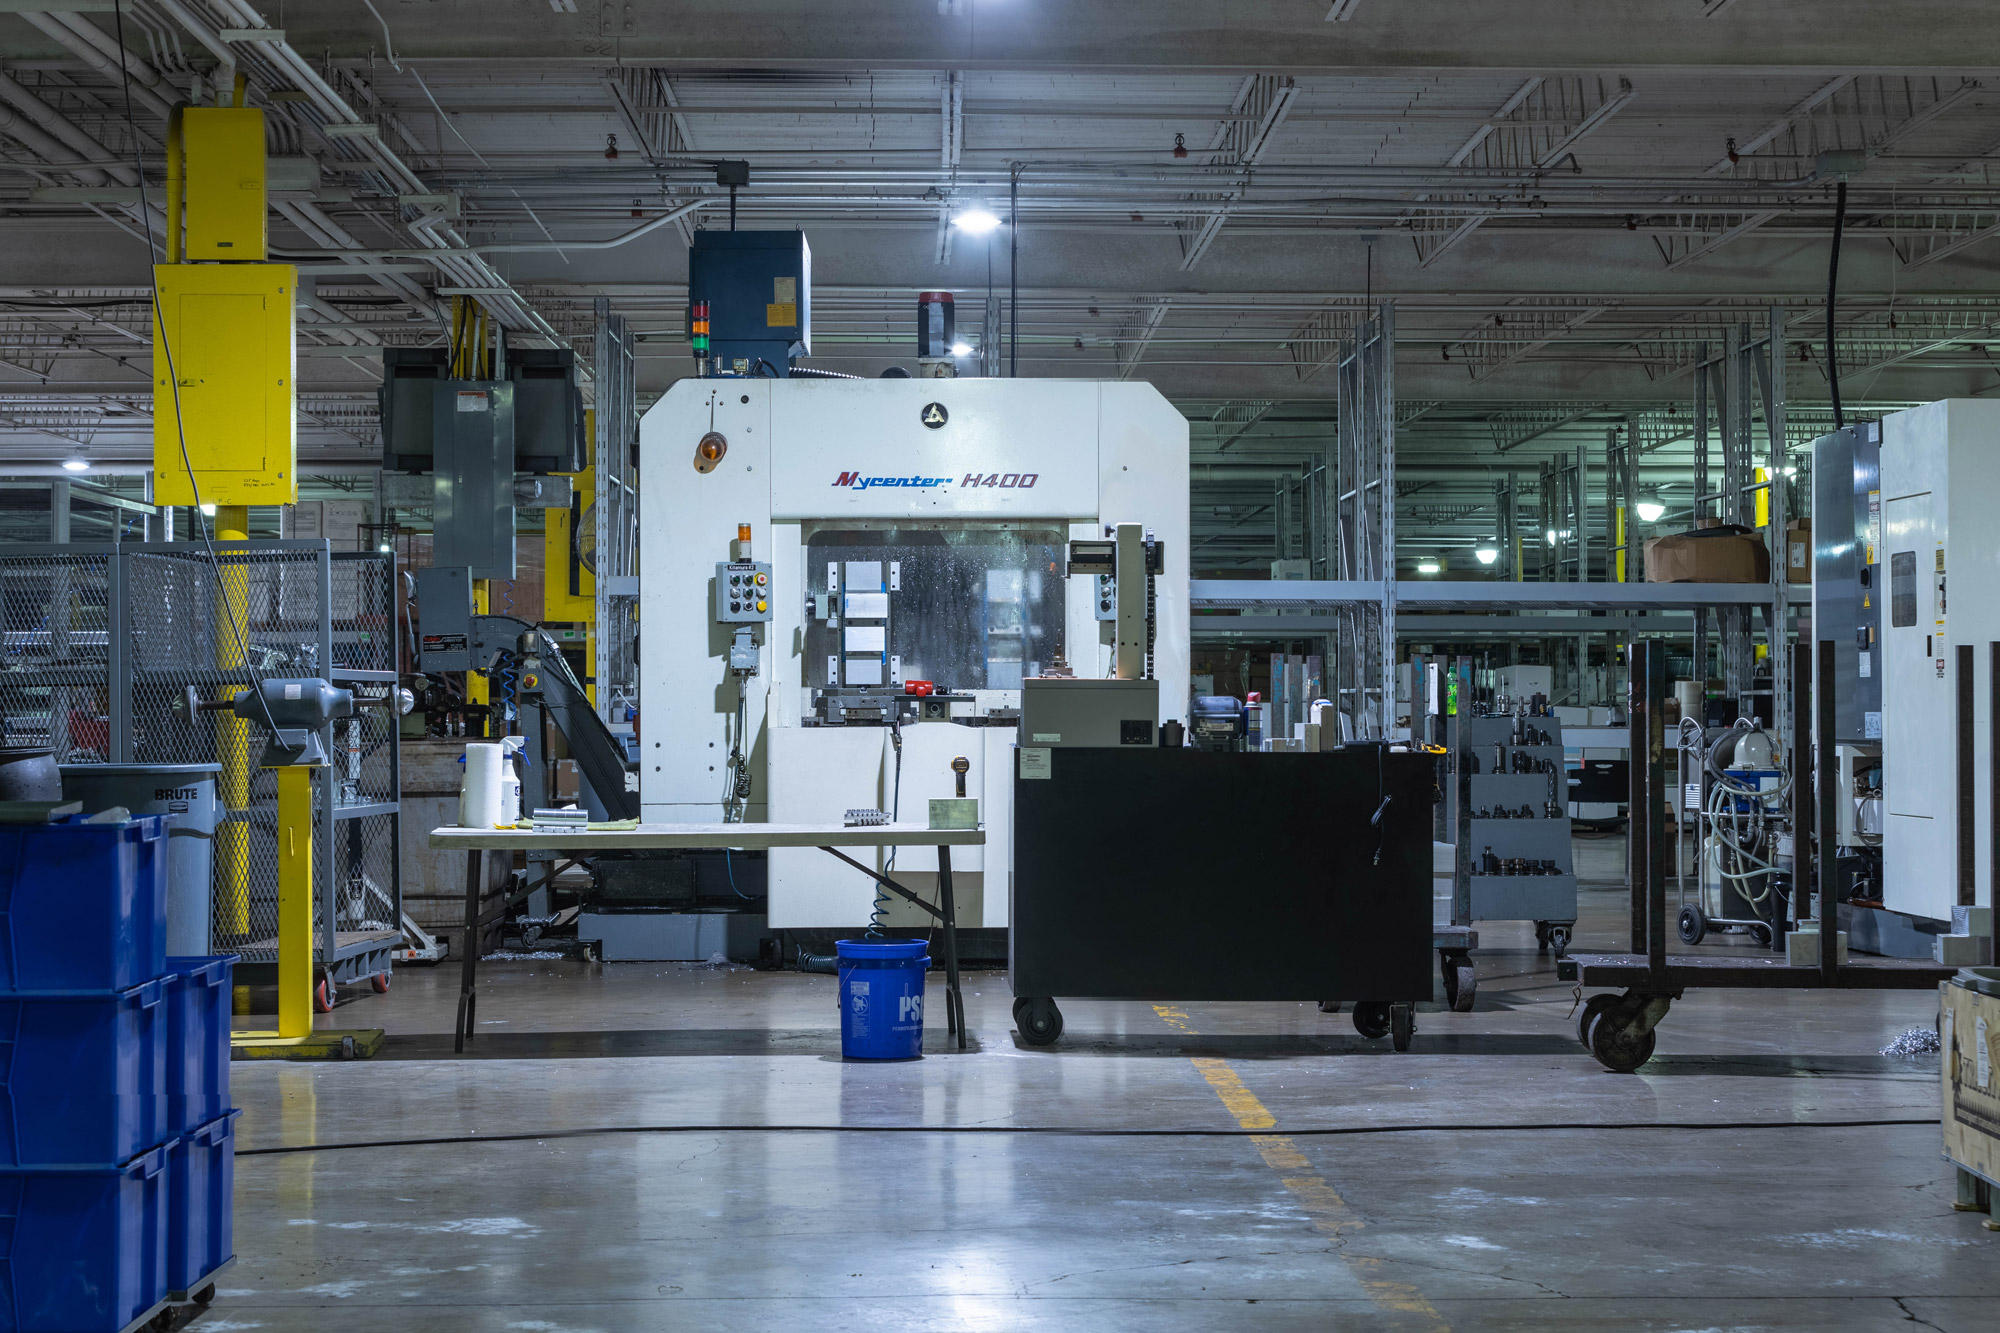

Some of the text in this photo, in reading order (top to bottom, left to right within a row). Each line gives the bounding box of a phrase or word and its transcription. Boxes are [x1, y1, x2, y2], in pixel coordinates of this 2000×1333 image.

[832, 472, 1039, 490] Mycenter H400
[155, 788, 198, 800] BRUTE
